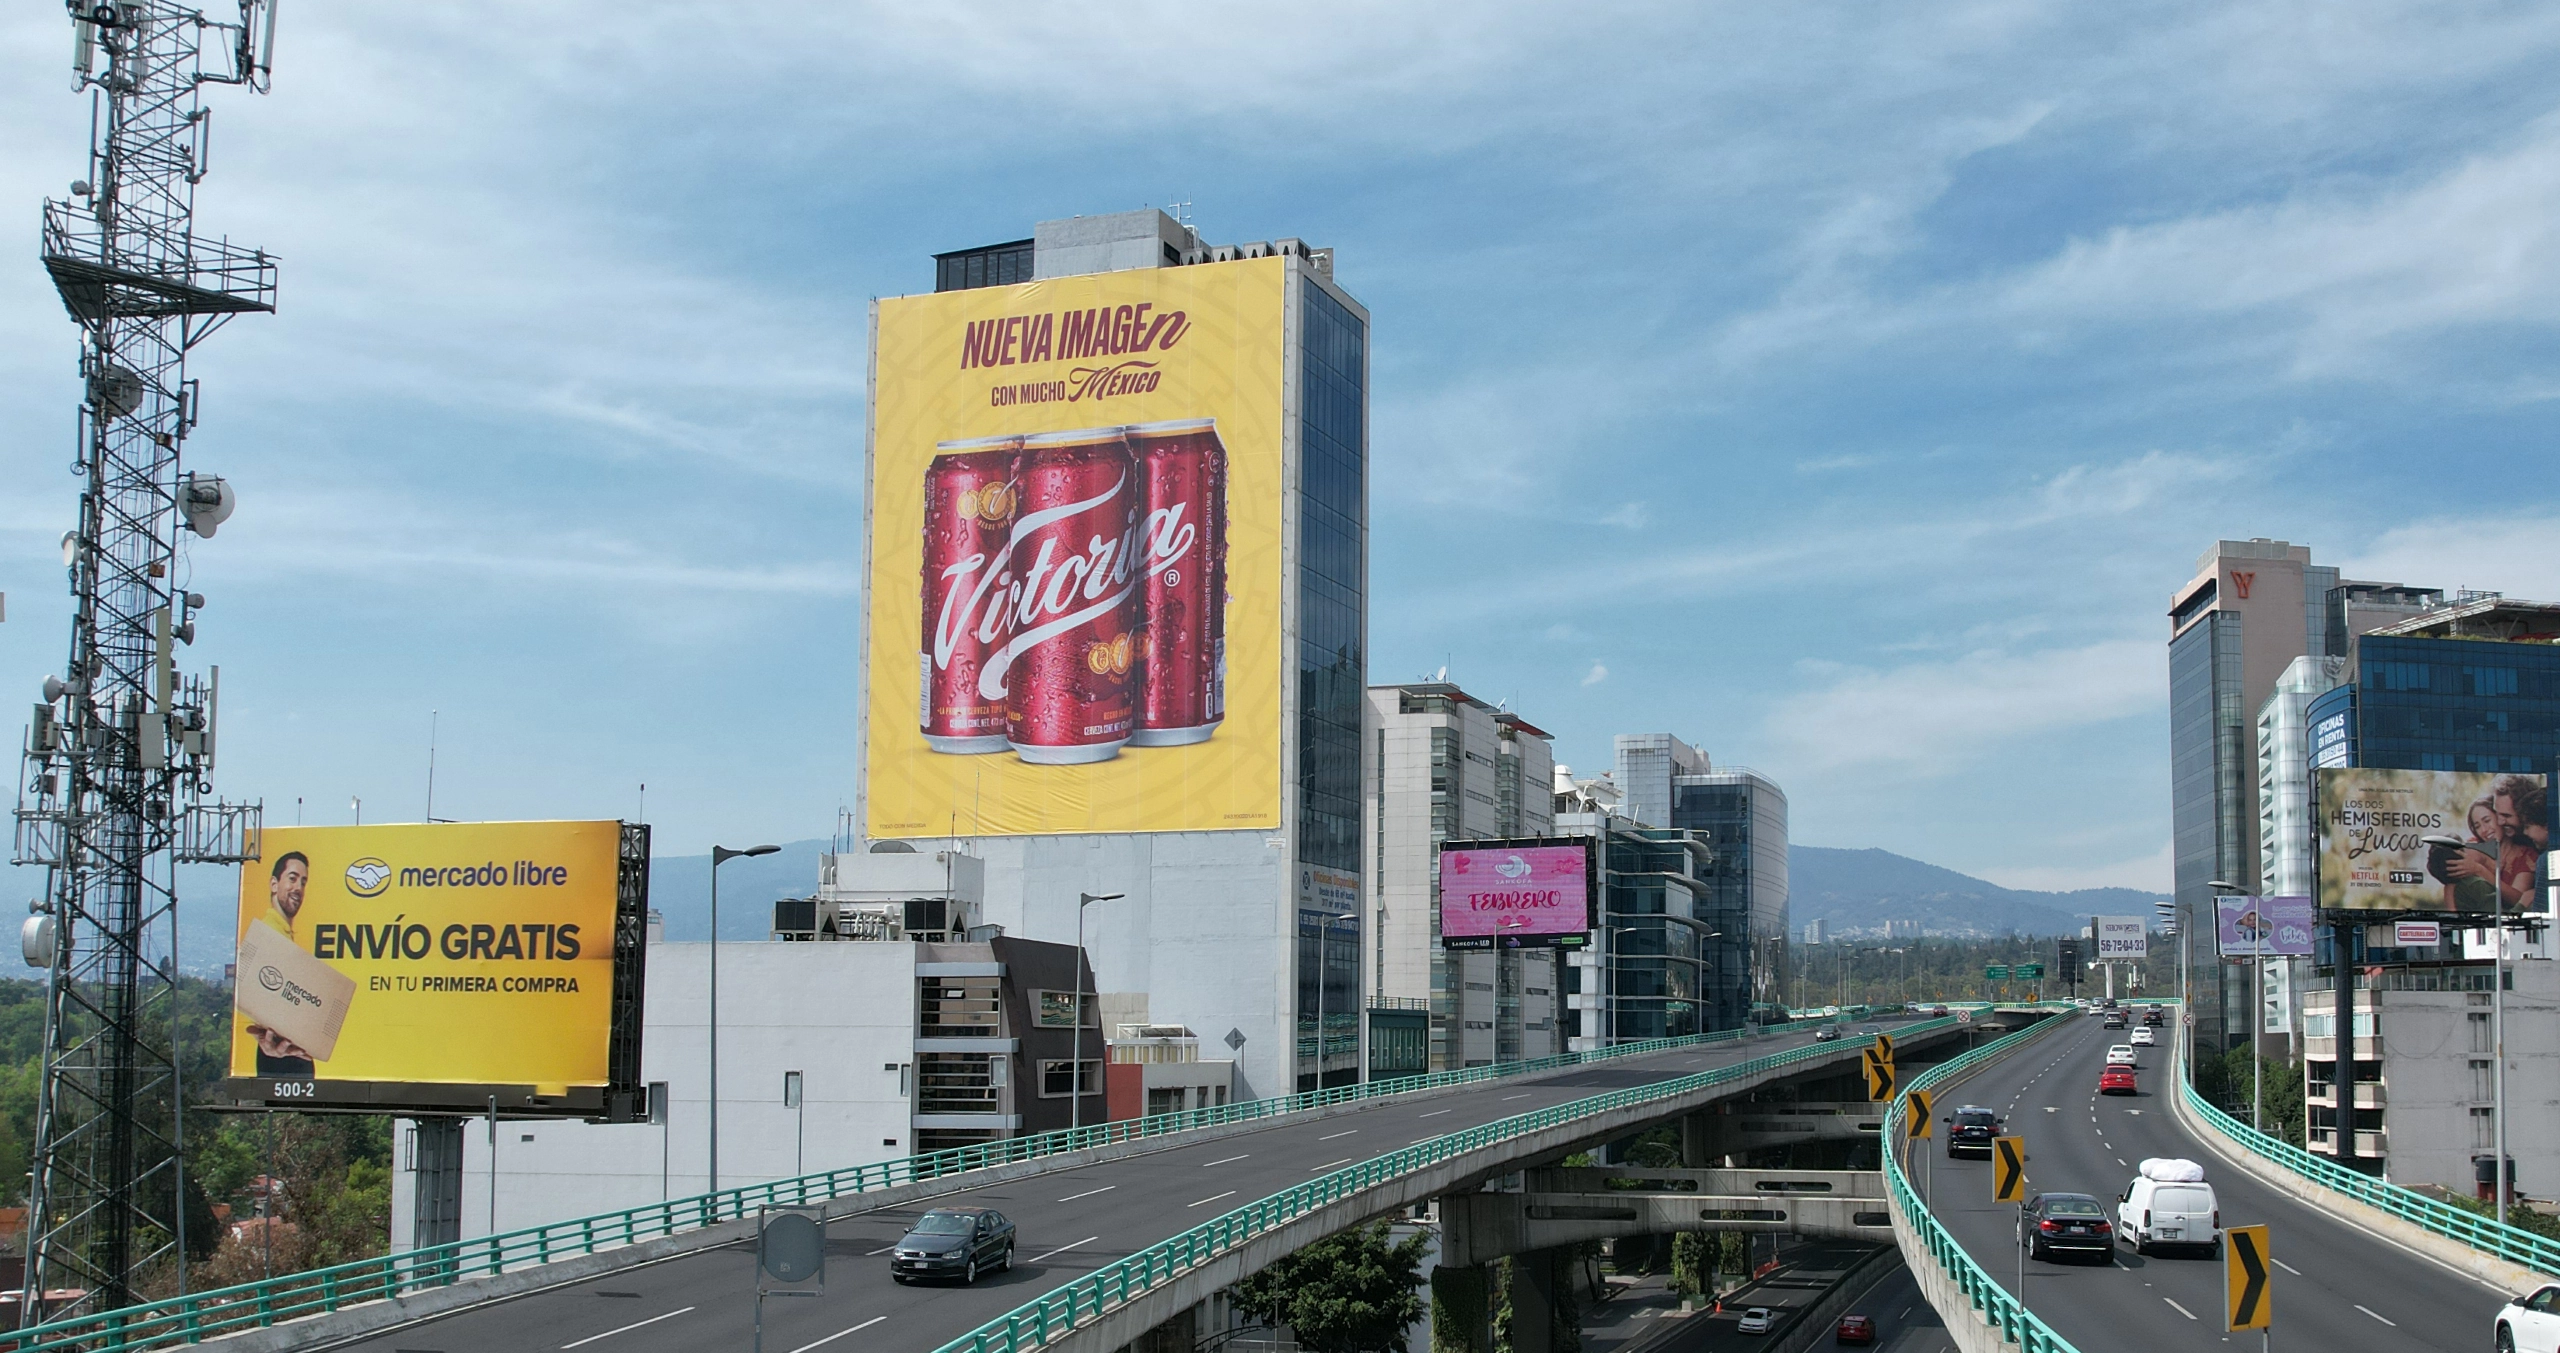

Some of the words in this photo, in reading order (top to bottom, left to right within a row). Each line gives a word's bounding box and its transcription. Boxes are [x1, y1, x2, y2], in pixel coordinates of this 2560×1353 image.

[960, 312, 1053, 370] NUEVA
[1057, 302, 1191, 360] IMAGEn
[991, 386, 1017, 407] CON
[1020, 380, 1065, 405] MUCHO
[1068, 360, 1161, 403] MÉXICO
[934, 466, 1196, 700] Victoria
[2317, 713, 2345, 737] OFICINAS
[2324, 728, 2346, 747] RENTA
[2345, 800, 2363, 809] LOS
[2365, 801, 2384, 809] DOS
[2331, 810, 2442, 829] HEMISFERIOS
[2348, 826, 2424, 860] Lucca
[2349, 829, 2361, 838] DE
[400, 861, 508, 887] mercado
[513, 860, 568, 886] libre
[2351, 872, 2380, 881] NETFLIX
[1468, 890, 1562, 912] FEBRERO
[315, 914, 432, 960] ENVÍO
[440, 923, 581, 961] GRATIS
[286, 980, 322, 1008] mercado
[369, 976, 391, 992] EN
[397, 976, 417, 992] TU
[422, 976, 498, 993] PRIMERA
[502, 977, 579, 993] COMPRA
[281, 988, 301, 1006] libre
[274, 1082, 315, 1097] 500-2
